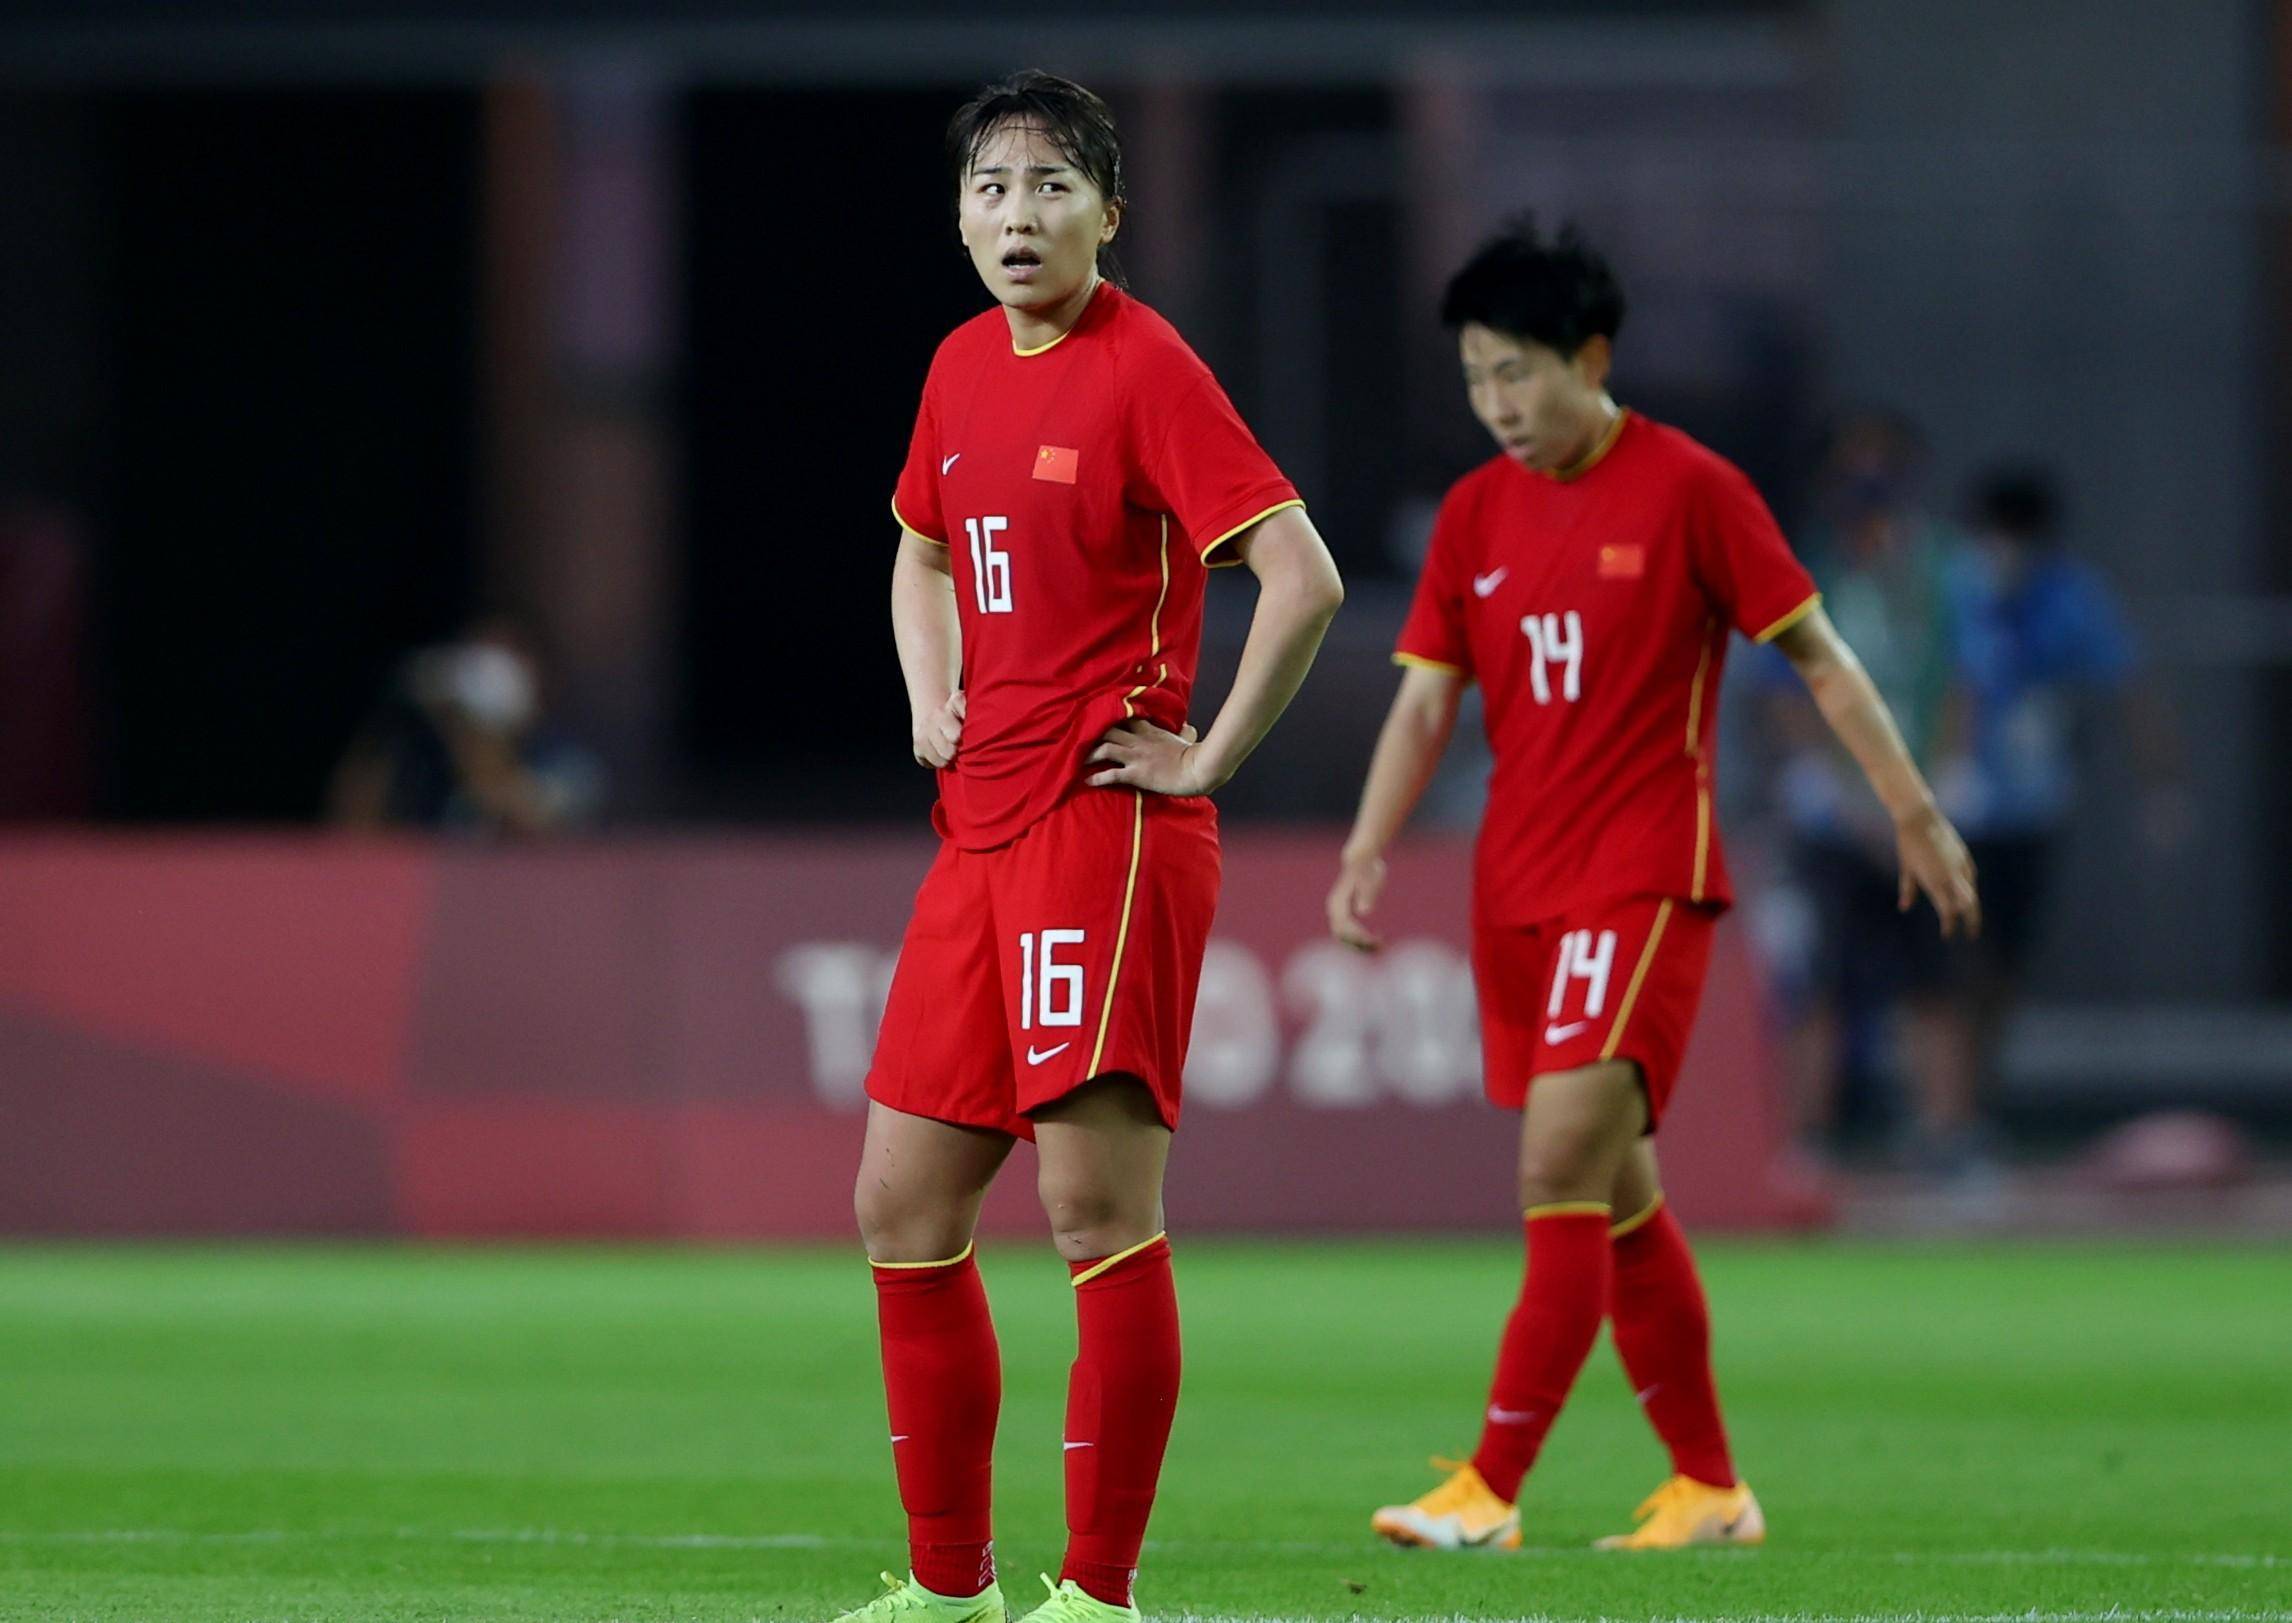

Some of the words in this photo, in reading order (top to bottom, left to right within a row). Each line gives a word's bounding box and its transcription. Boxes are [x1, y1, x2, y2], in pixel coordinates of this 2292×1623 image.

[965, 515, 1013, 615] 16
[1520, 609, 1583, 705] 14
[1019, 928, 1085, 1030] 16
[1546, 928, 1617, 1019] 14
